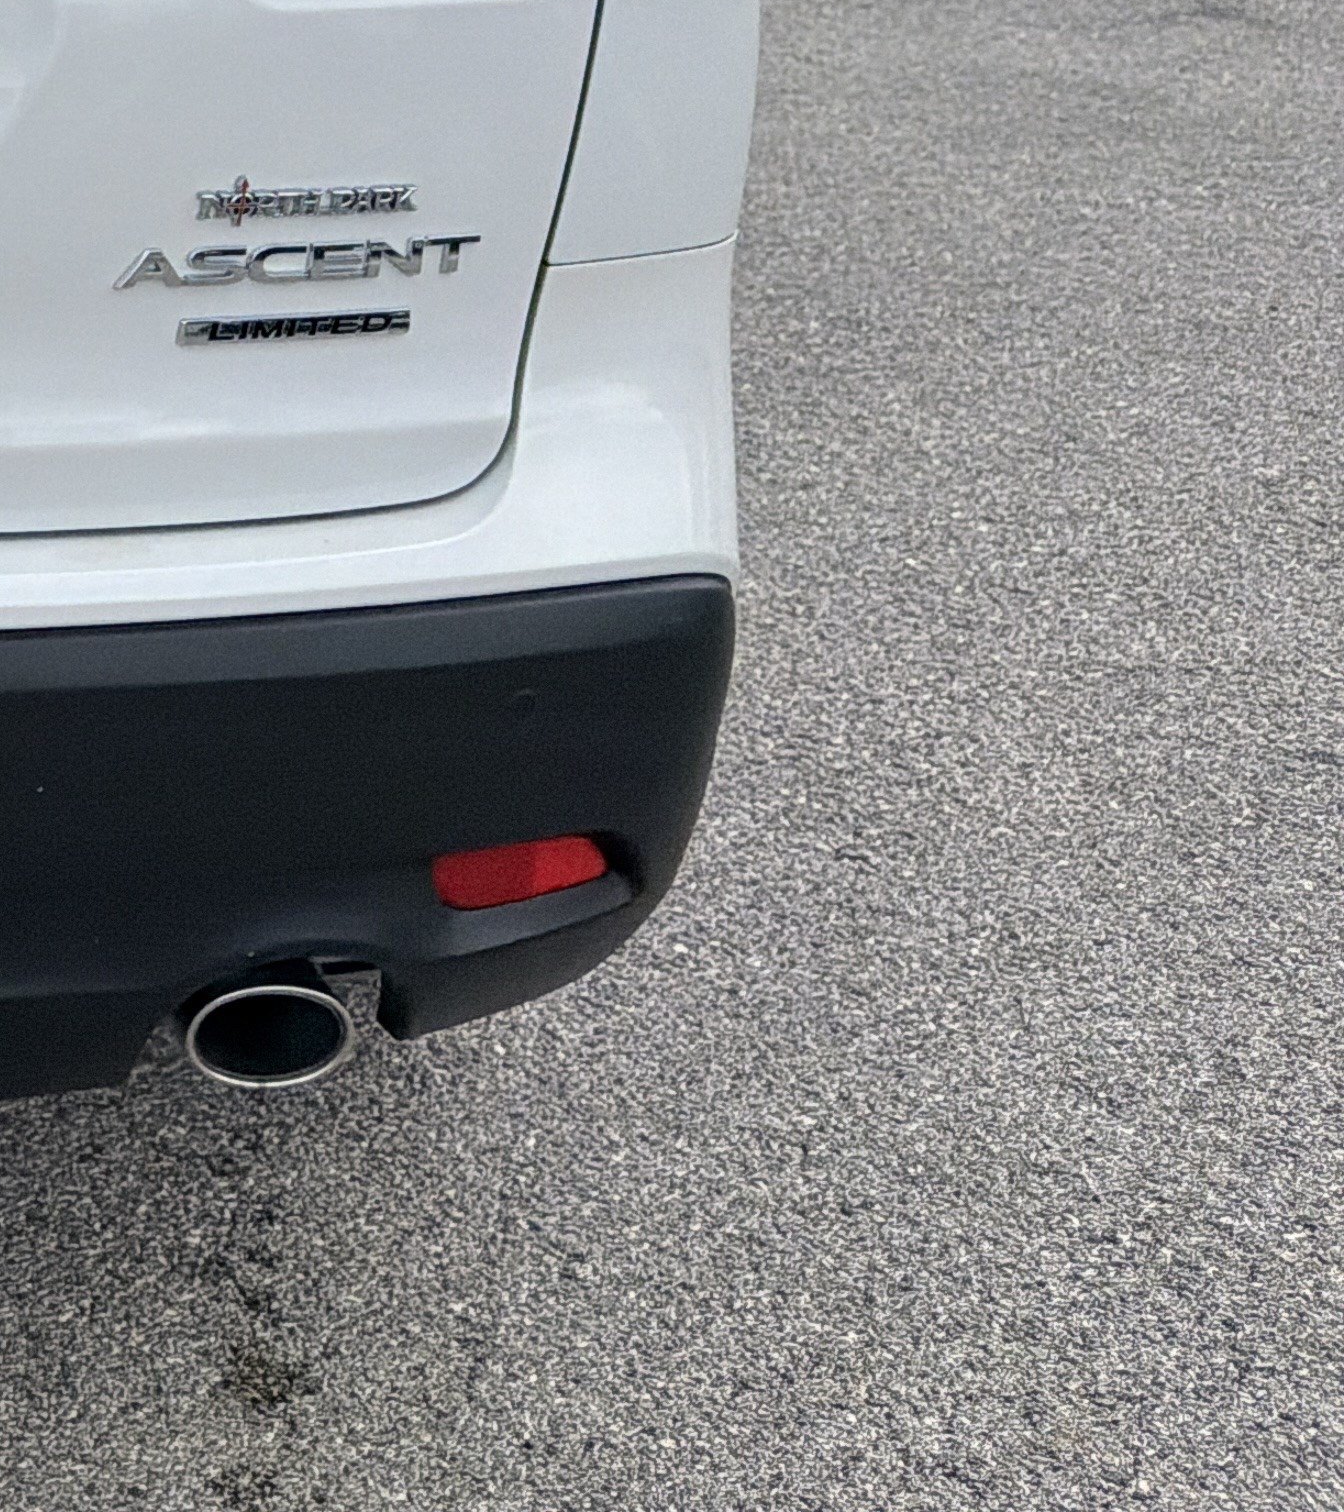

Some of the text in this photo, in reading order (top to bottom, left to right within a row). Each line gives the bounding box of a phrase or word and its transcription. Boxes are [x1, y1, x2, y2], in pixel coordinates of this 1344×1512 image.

[196, 181, 418, 223] NORTH PARK
[113, 235, 482, 289] ASCENT
[206, 315, 392, 341] LIMITED
